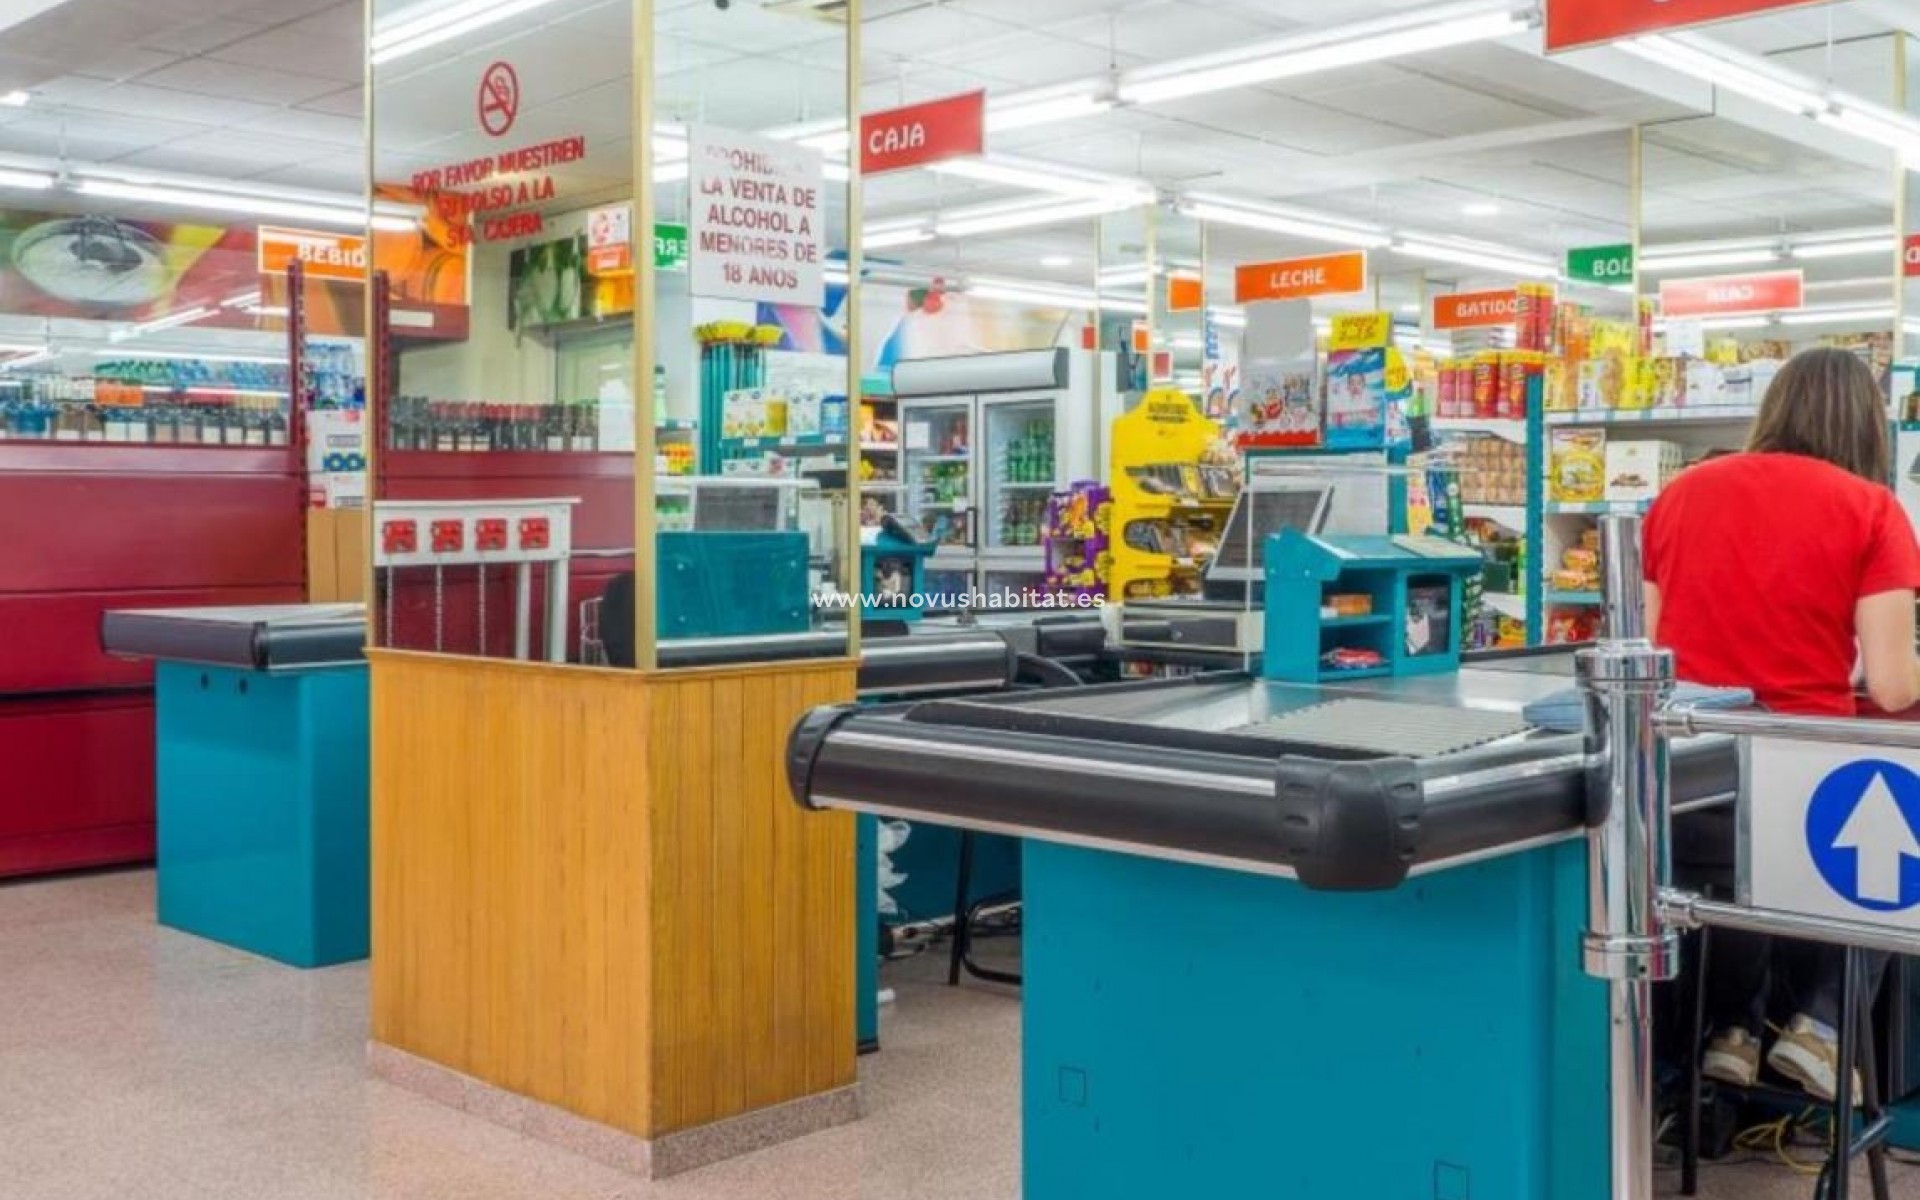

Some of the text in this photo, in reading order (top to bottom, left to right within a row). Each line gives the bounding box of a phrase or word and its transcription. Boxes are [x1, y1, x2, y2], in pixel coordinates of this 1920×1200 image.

[868, 121, 926, 155] CAJA
[412, 136, 585, 194] POR FAVOR MUESTREN
[517, 181, 530, 204] A
[534, 174, 555, 201] LA
[701, 177, 816, 209] LA VENTA DE
[707, 204, 811, 237] ALCOHOL A
[700, 231, 817, 264] MENORES DE
[723, 261, 742, 284] 18
[1269, 266, 1326, 290] LECHE
